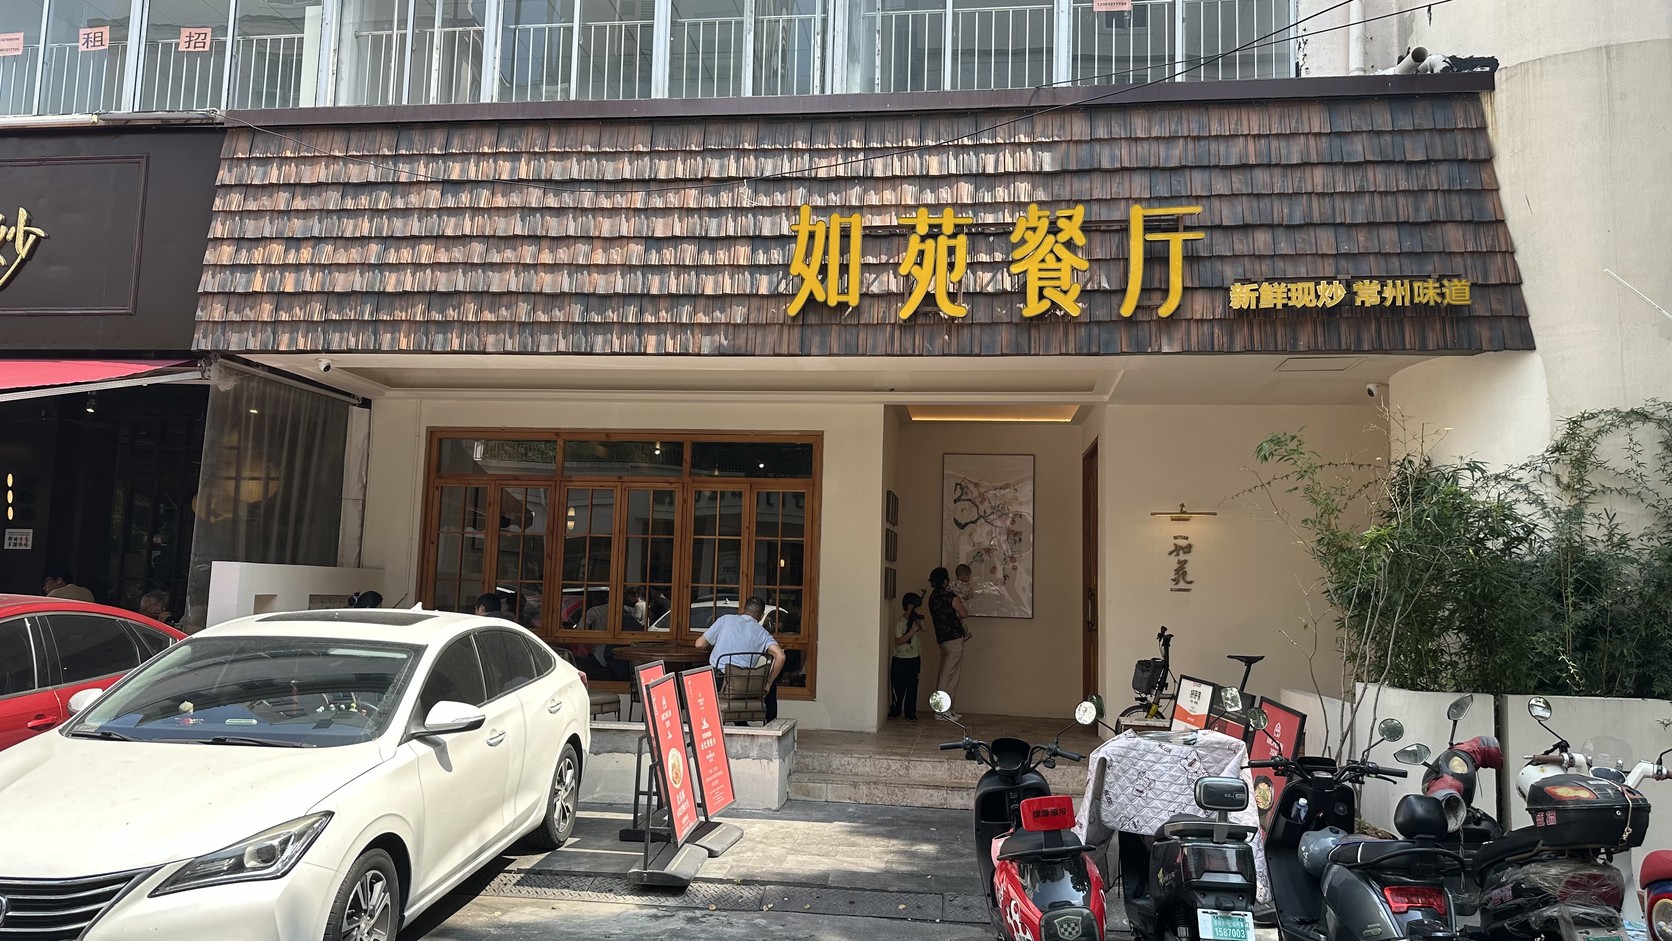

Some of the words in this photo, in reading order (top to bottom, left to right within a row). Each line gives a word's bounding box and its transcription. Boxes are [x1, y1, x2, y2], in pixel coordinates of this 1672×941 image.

[82, 31, 105, 49] 租
[184, 32, 208, 50] 招
[787, 203, 1206, 319] 如苑餐厅
[1229, 280, 1347, 309] 新鲜现炒
[1352, 278, 1472, 306] 常州味道
[1214, 927, 1246, 939] 1587003
